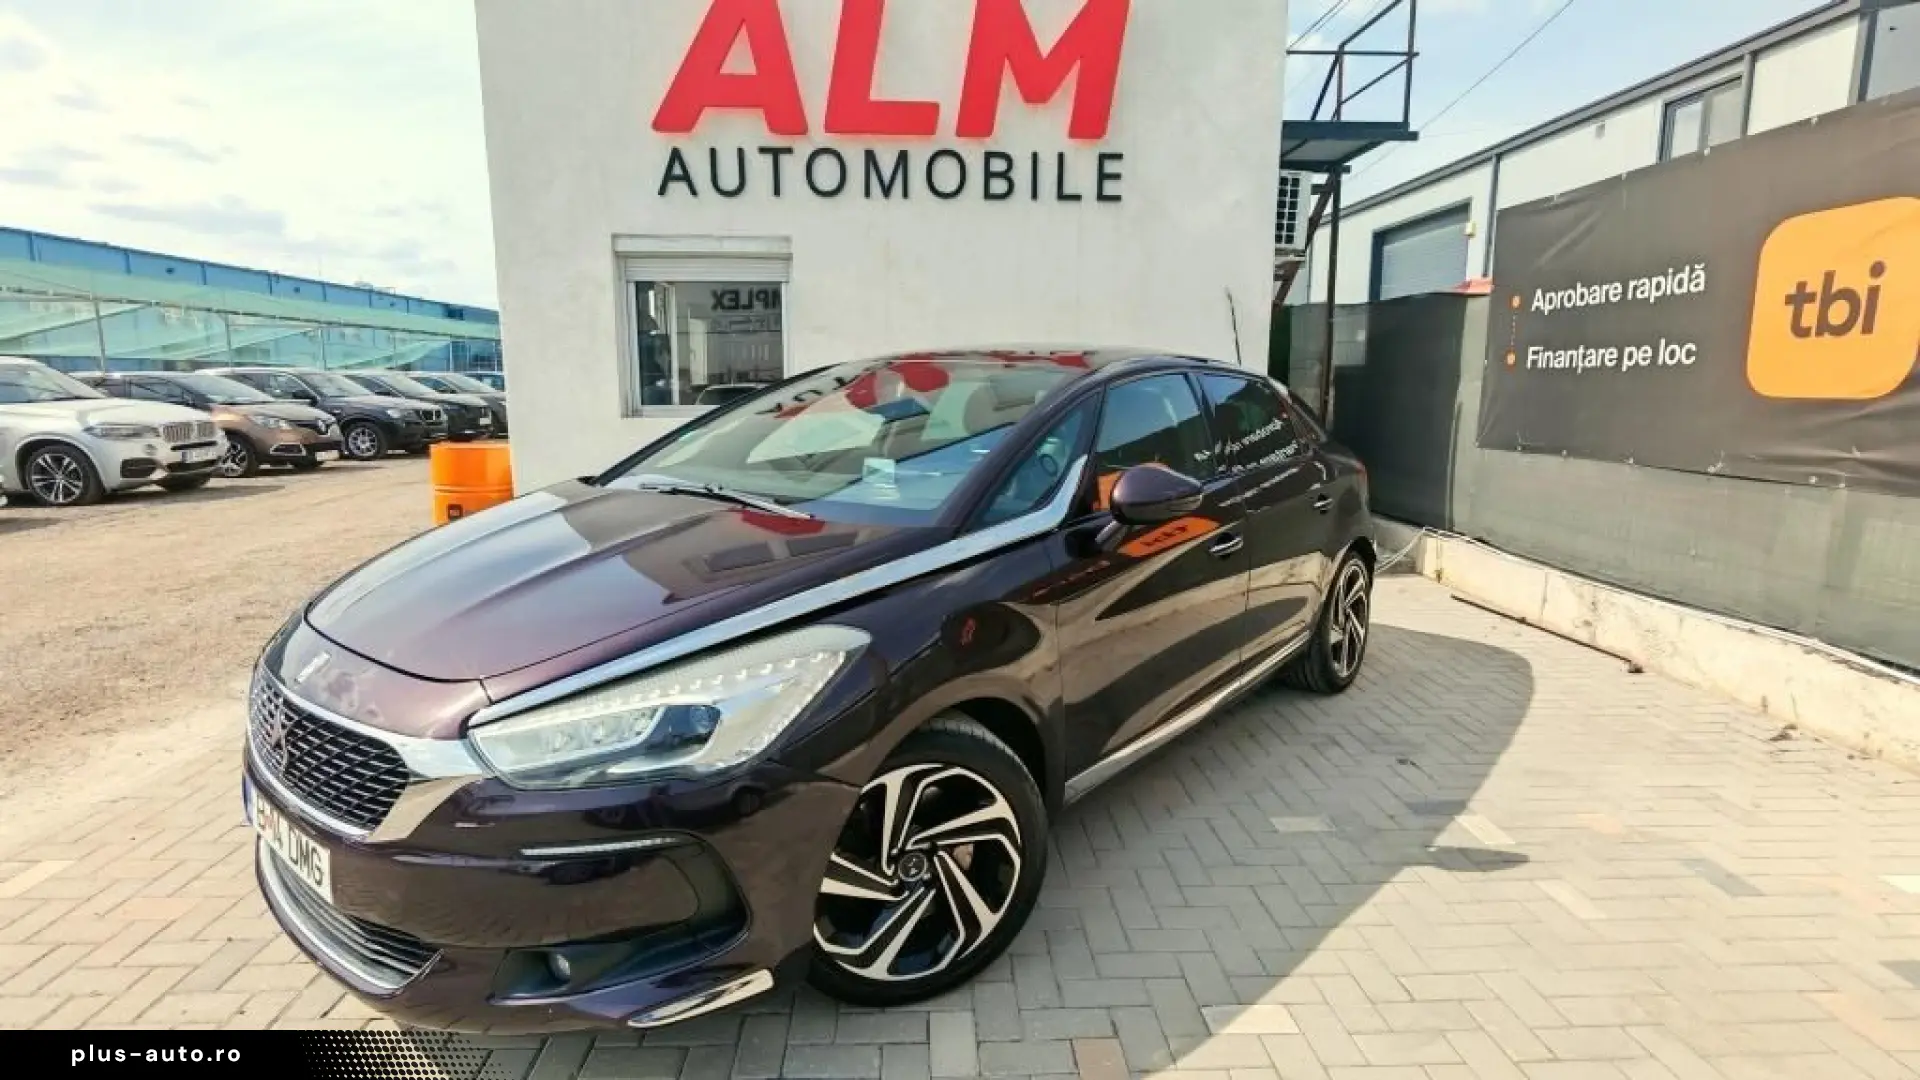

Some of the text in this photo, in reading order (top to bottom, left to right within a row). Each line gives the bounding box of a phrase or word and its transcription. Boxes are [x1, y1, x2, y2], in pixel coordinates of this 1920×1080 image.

[651, 0, 1132, 138] ALM
[657, 146, 1125, 202] AUTOMOBILE
[1531, 262, 1707, 315] Aprobare rapidă
[1784, 259, 1887, 339] tbi
[1526, 337, 1697, 374] Finanțare pe loc
[288, 822, 324, 887] DMG
